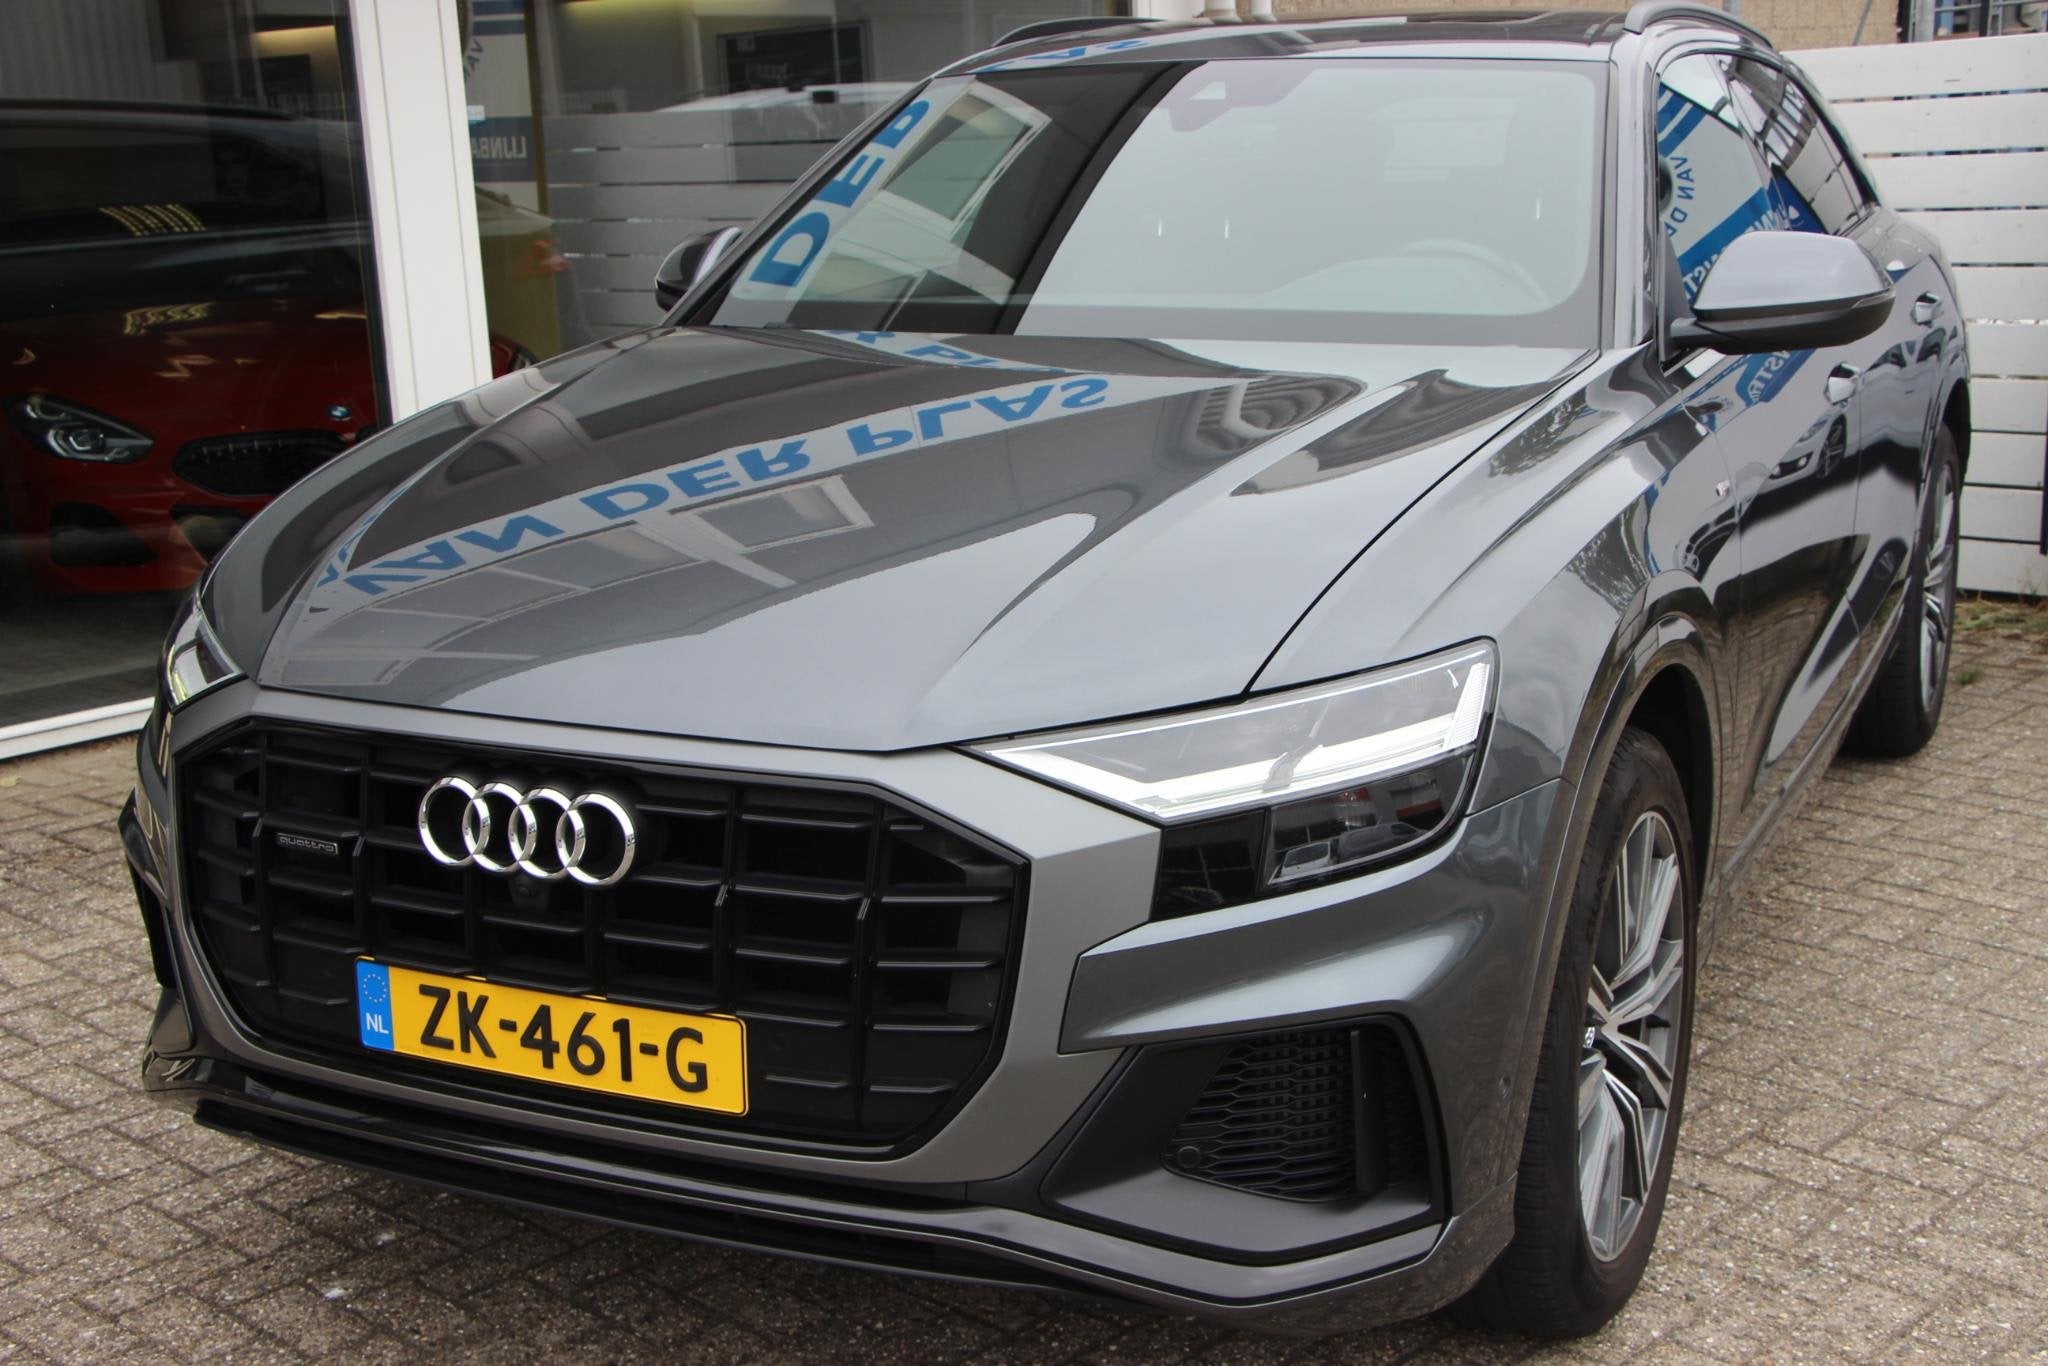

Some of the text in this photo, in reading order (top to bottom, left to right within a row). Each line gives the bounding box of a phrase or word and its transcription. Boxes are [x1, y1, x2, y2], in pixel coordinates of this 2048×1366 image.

[279, 835, 335, 852] quattro
[366, 1012, 389, 1036] NL
[419, 983, 708, 1094] ZK-461-G
